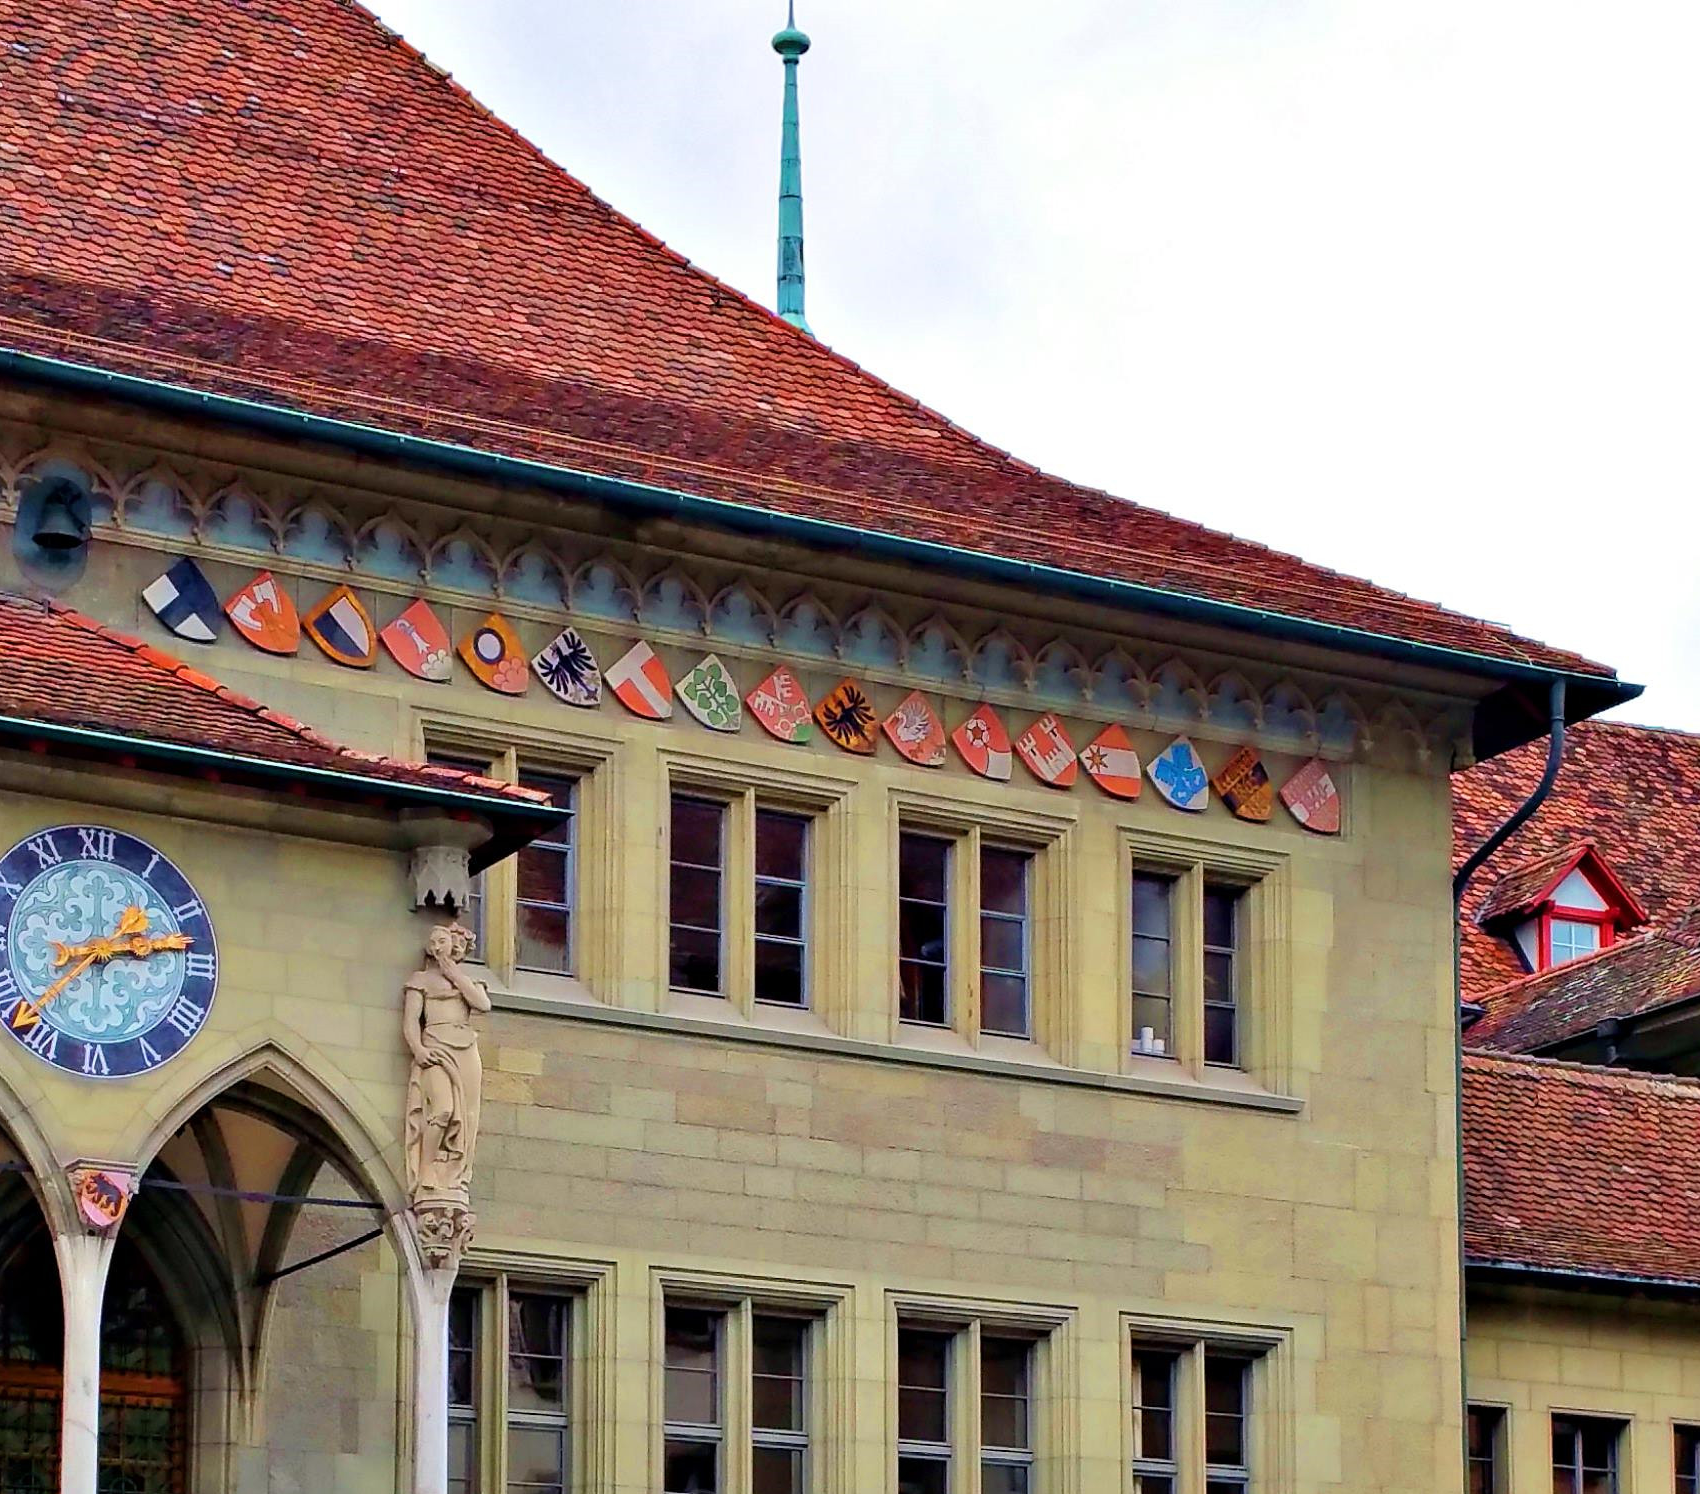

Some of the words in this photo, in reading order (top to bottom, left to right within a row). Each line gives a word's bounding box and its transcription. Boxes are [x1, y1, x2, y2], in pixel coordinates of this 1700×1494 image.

[28, 834, 62, 869] XI
[78, 828, 116, 861] XII
[142, 854, 161, 879] I
[173, 899, 201, 922] II
[186, 951, 215, 981] III
[167, 995, 206, 1038] IIII
[82, 1042, 110, 1075] VI
[138, 1037, 162, 1068] V
